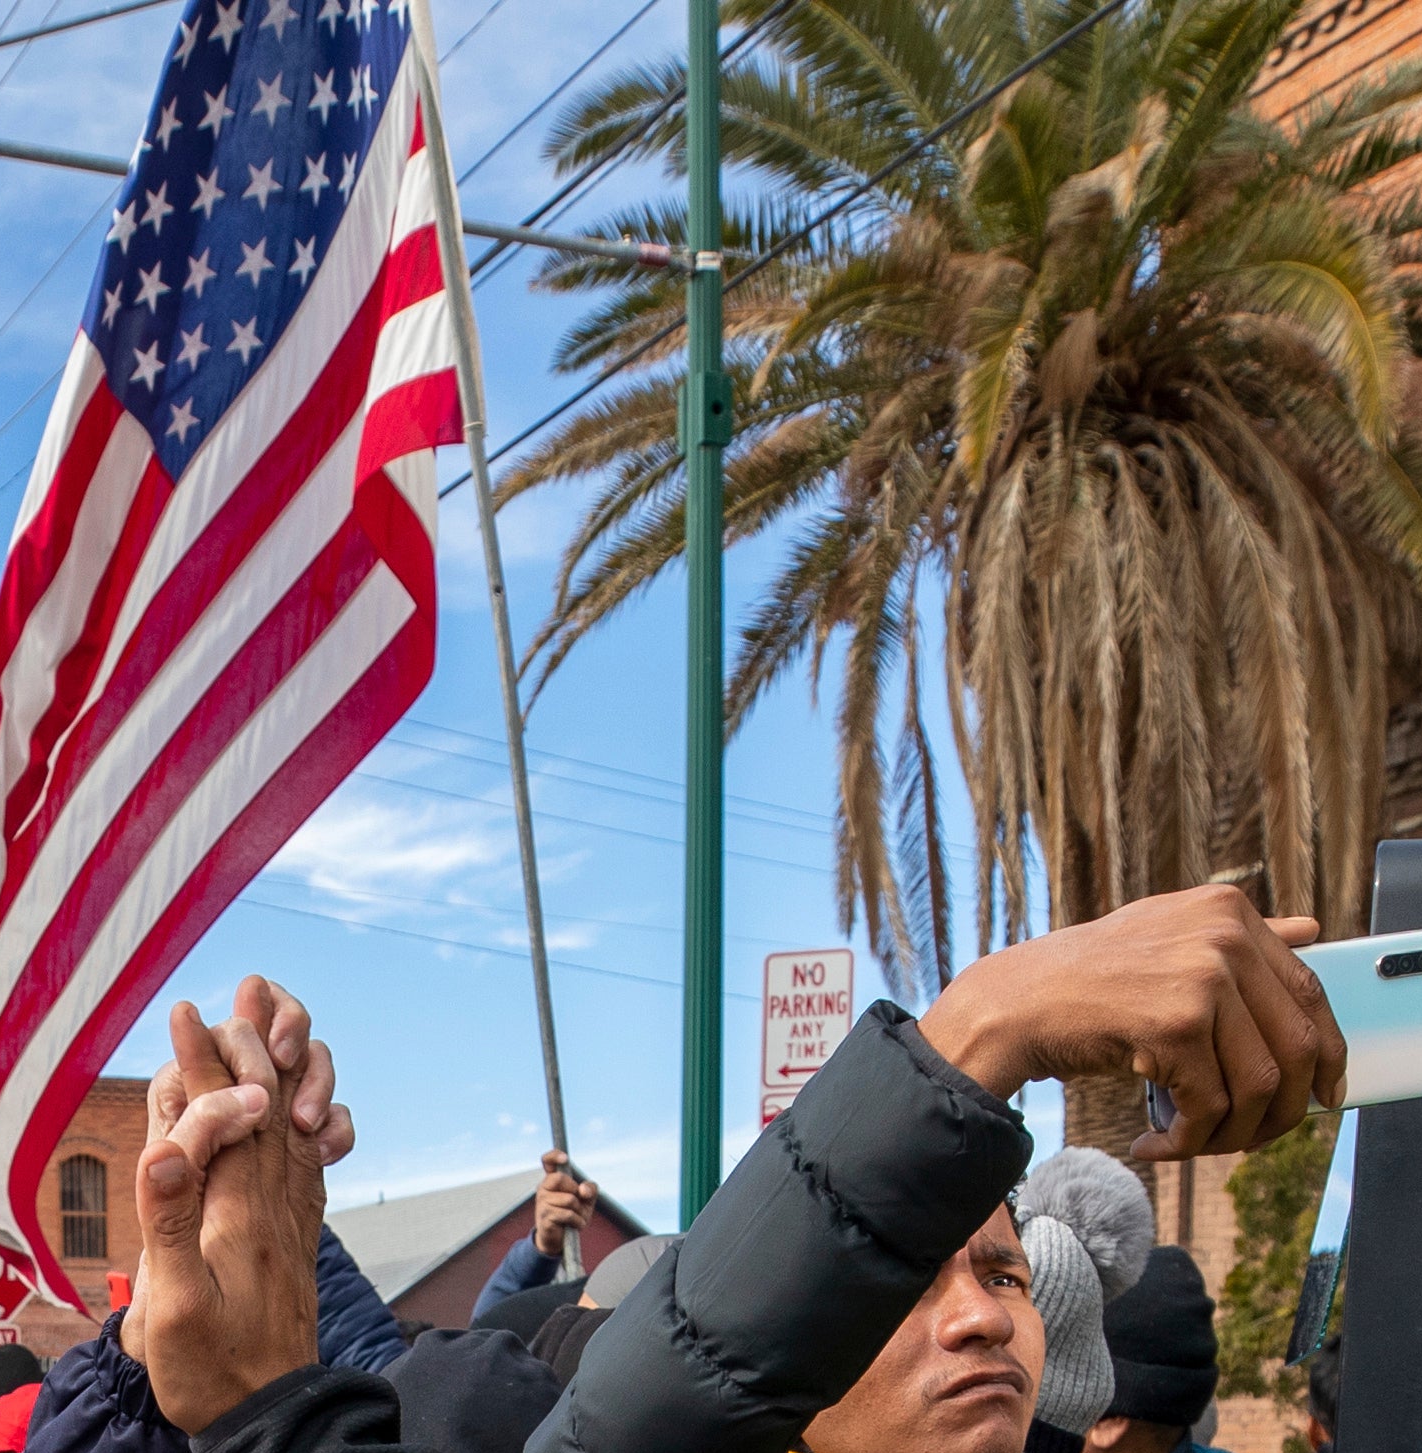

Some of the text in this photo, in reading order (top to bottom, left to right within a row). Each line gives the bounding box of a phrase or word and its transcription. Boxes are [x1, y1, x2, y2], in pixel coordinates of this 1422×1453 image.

[792, 962, 826, 988] NO
[769, 990, 847, 1019] PARKING
[790, 1021, 826, 1039] ANY
[786, 1041, 828, 1059] TIME
